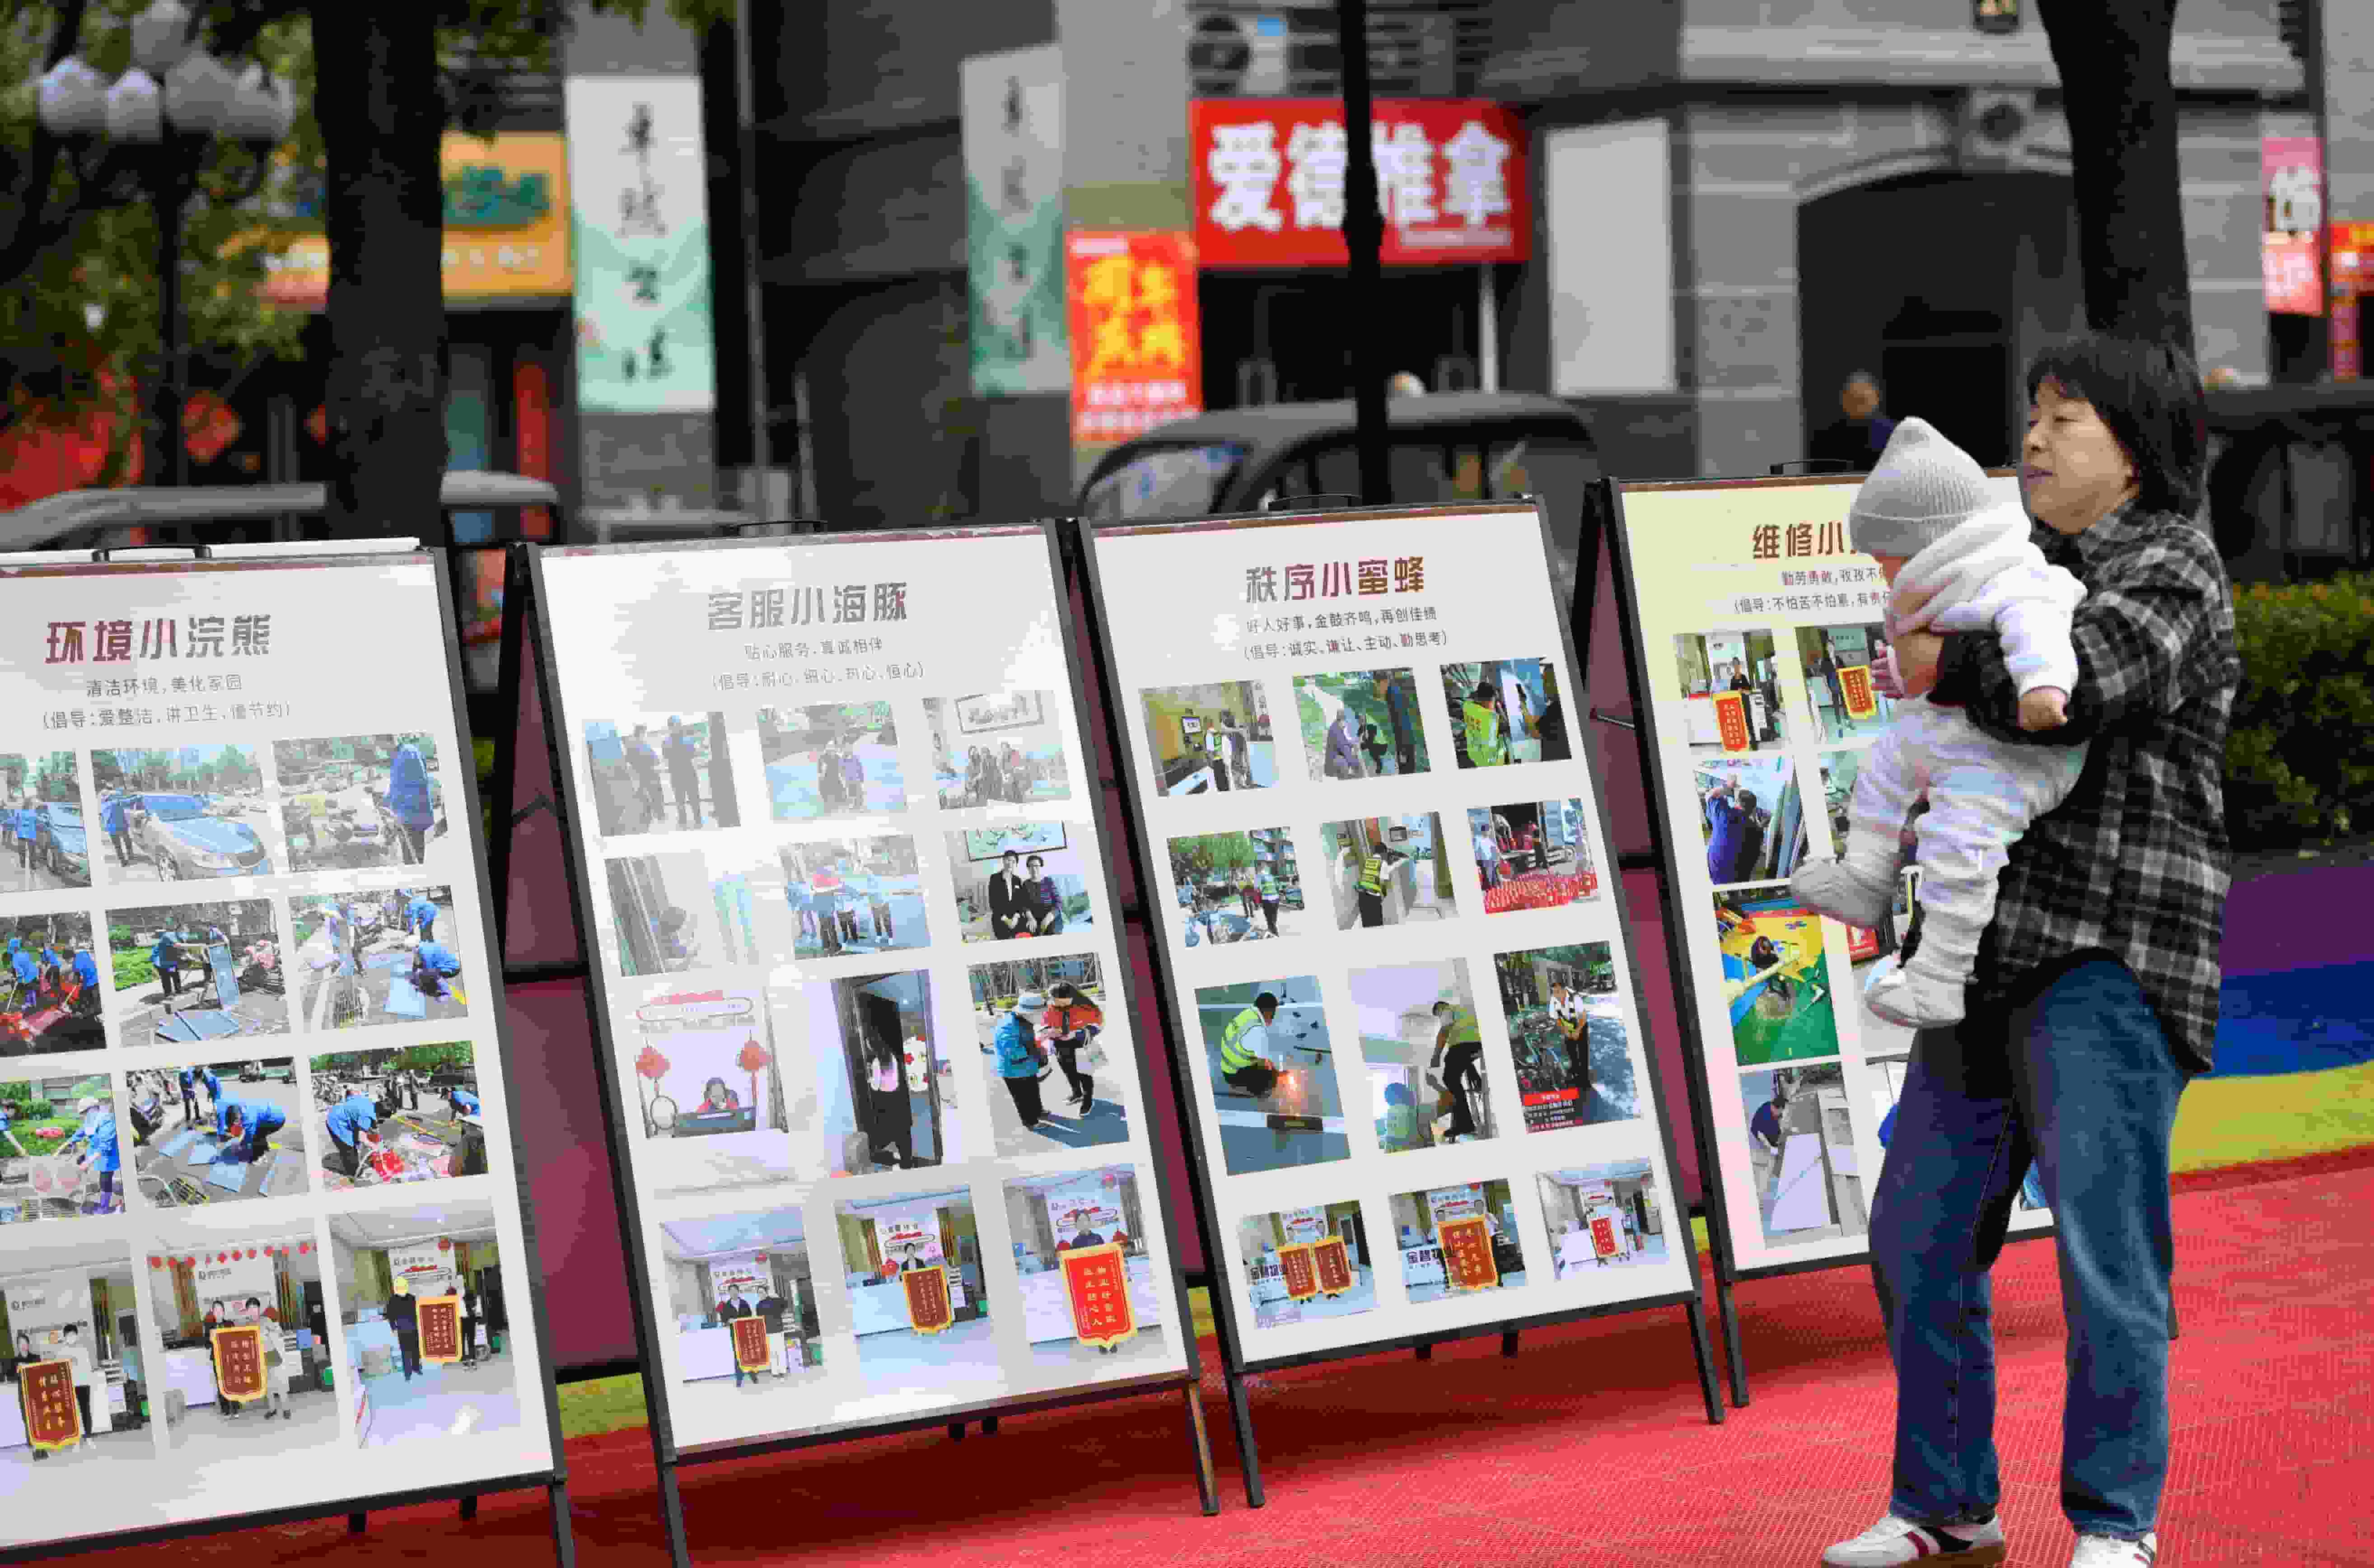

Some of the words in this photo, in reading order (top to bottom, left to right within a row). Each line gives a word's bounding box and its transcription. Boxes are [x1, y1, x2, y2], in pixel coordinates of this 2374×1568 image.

[1752, 520, 1857, 560] 维修小
[1246, 556, 1424, 603] 秩序小蜜蜂
[707, 581, 907, 632] 客服小海豚
[44, 613, 272, 664] 环境小浣熊
[87, 673, 242, 698] 清洁环境，美化家园
